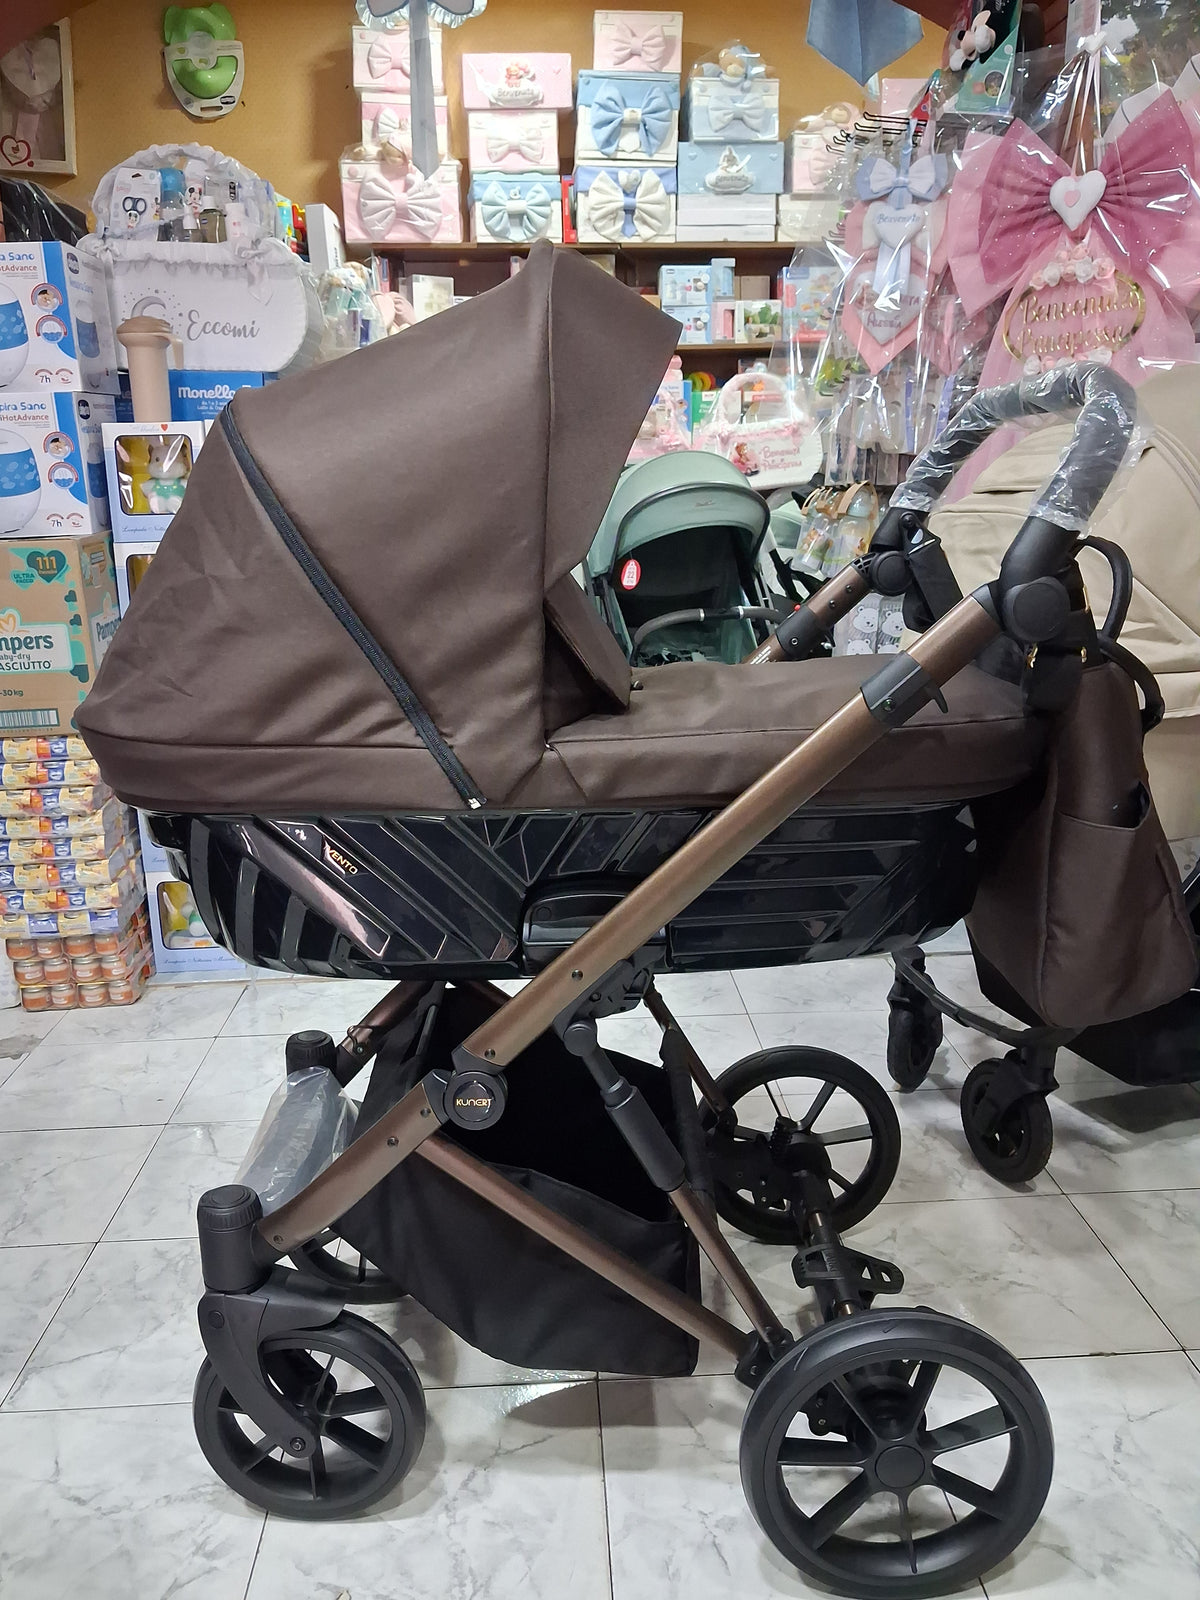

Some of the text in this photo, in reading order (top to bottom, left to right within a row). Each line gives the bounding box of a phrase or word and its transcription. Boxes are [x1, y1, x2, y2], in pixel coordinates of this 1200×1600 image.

[187, 309, 260, 342] Eccomi
[36, 556, 57, 570] 111
[456, 1098, 491, 1107] KUNERT
